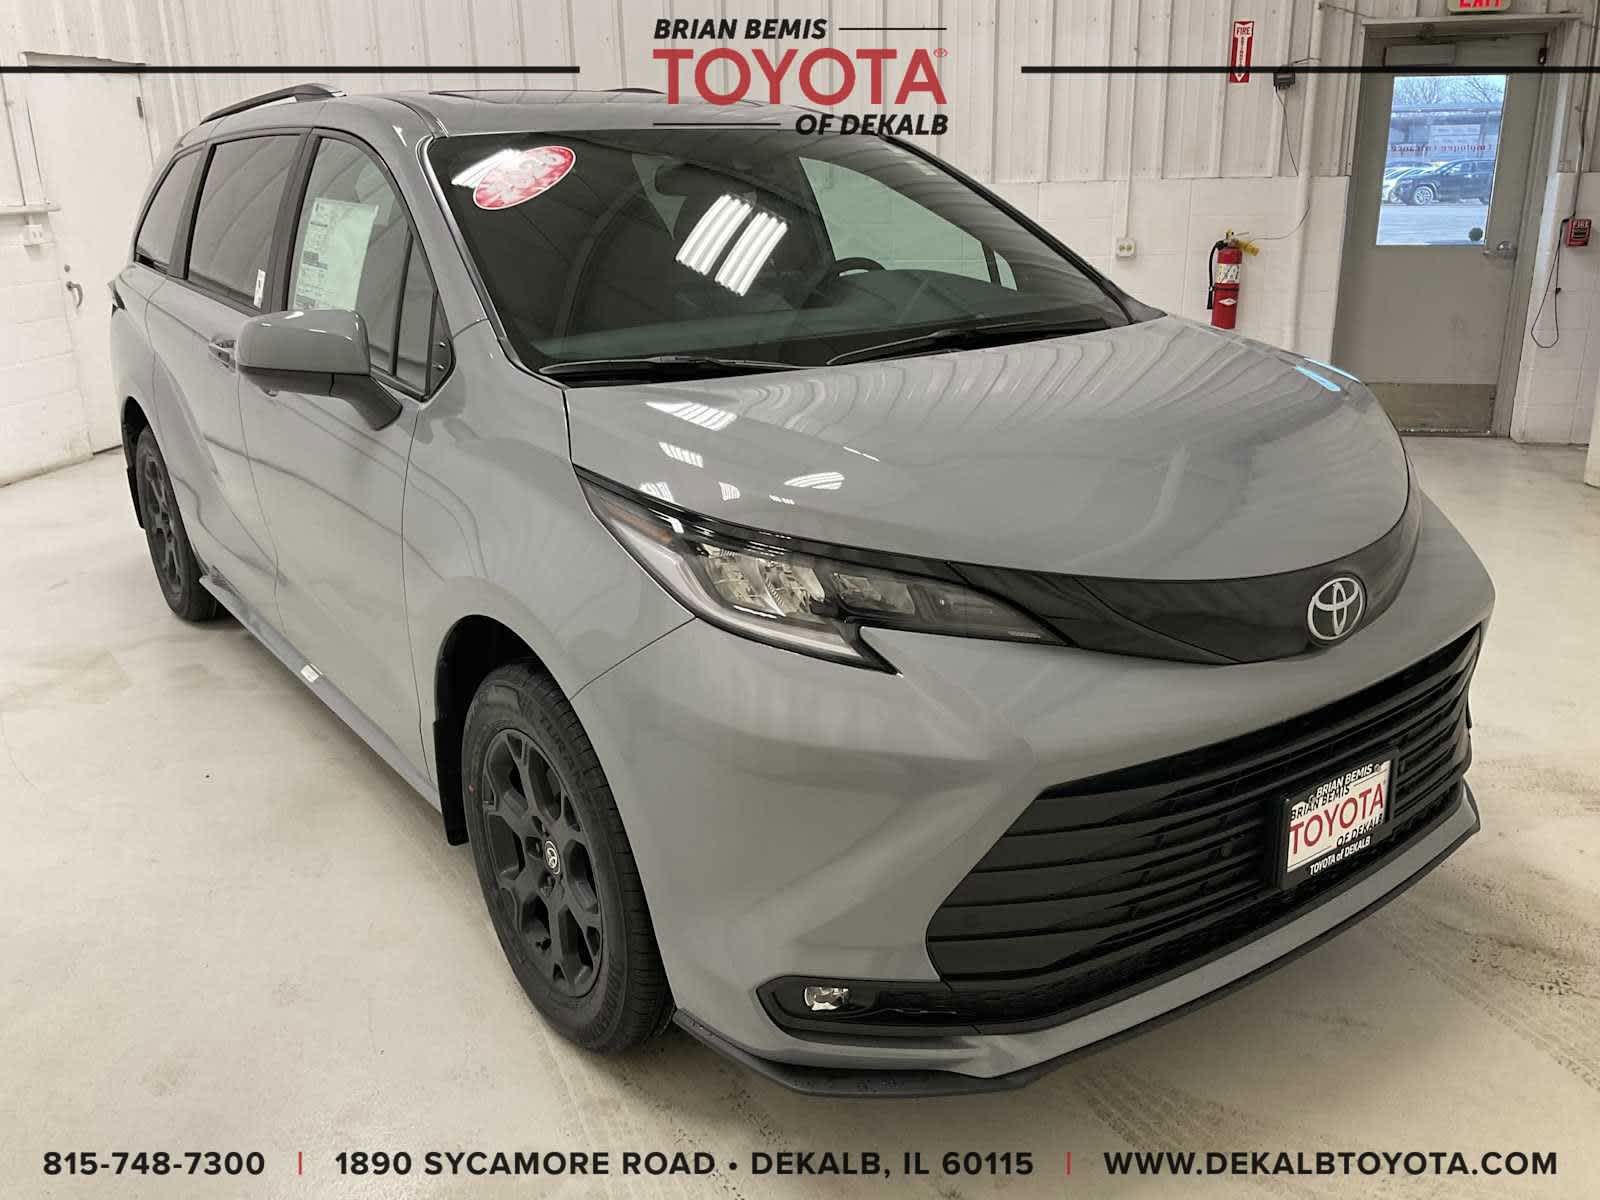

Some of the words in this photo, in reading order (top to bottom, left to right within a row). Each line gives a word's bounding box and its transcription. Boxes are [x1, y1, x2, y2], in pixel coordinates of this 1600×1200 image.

[1236, 26, 1251, 35] FIRE
[1316, 776, 1344, 797] BRIAN
[1345, 763, 1373, 783] BEMIS
[1290, 797, 1319, 820] BRIAN
[1321, 785, 1350, 806] BEMIS
[1290, 783, 1384, 854] TOYOTA
[1310, 857, 1336, 876] TOYOTA
[1344, 835, 1371, 857] DEKALB
[1336, 832, 1350, 848] OF
